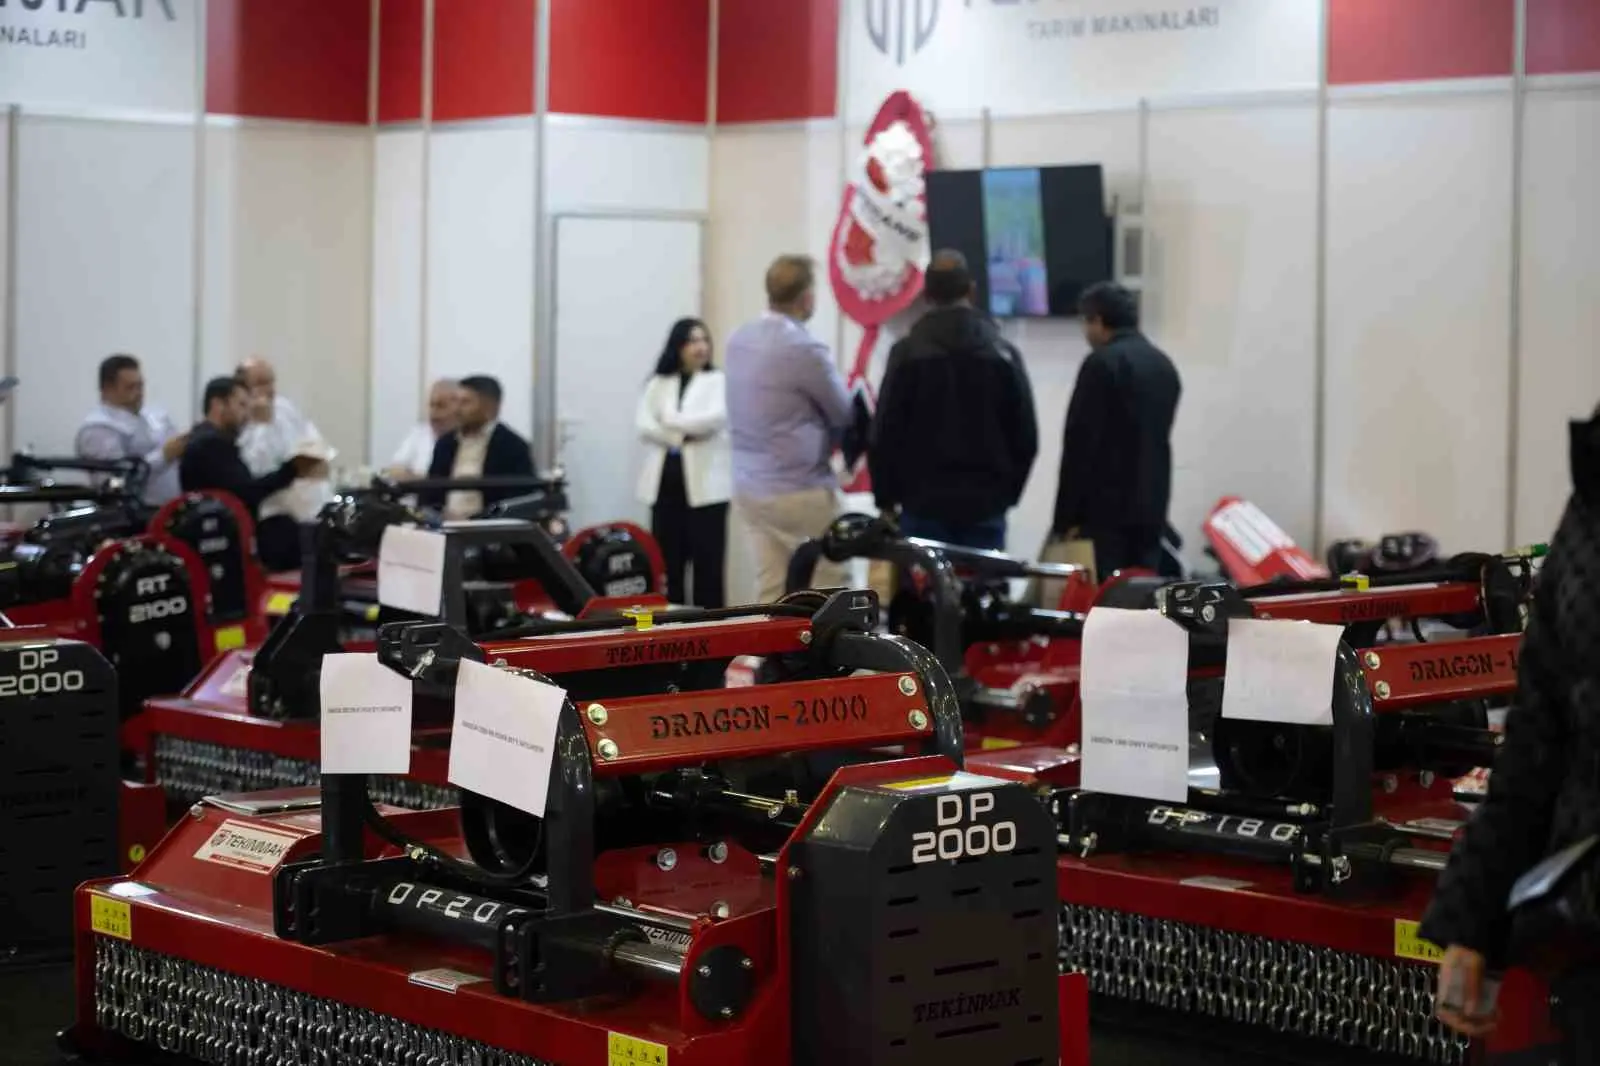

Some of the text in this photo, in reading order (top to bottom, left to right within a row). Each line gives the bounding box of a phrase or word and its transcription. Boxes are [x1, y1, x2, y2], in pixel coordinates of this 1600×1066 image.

[136, 574, 171, 596] RT
[19, 650, 59, 670] DP
[0, 670, 84, 696] 2000
[650, 694, 867, 739] DRAGON-2000
[937, 792, 995, 826] DP
[912, 821, 1017, 864] 2000
[388, 882, 528, 924] DP20
